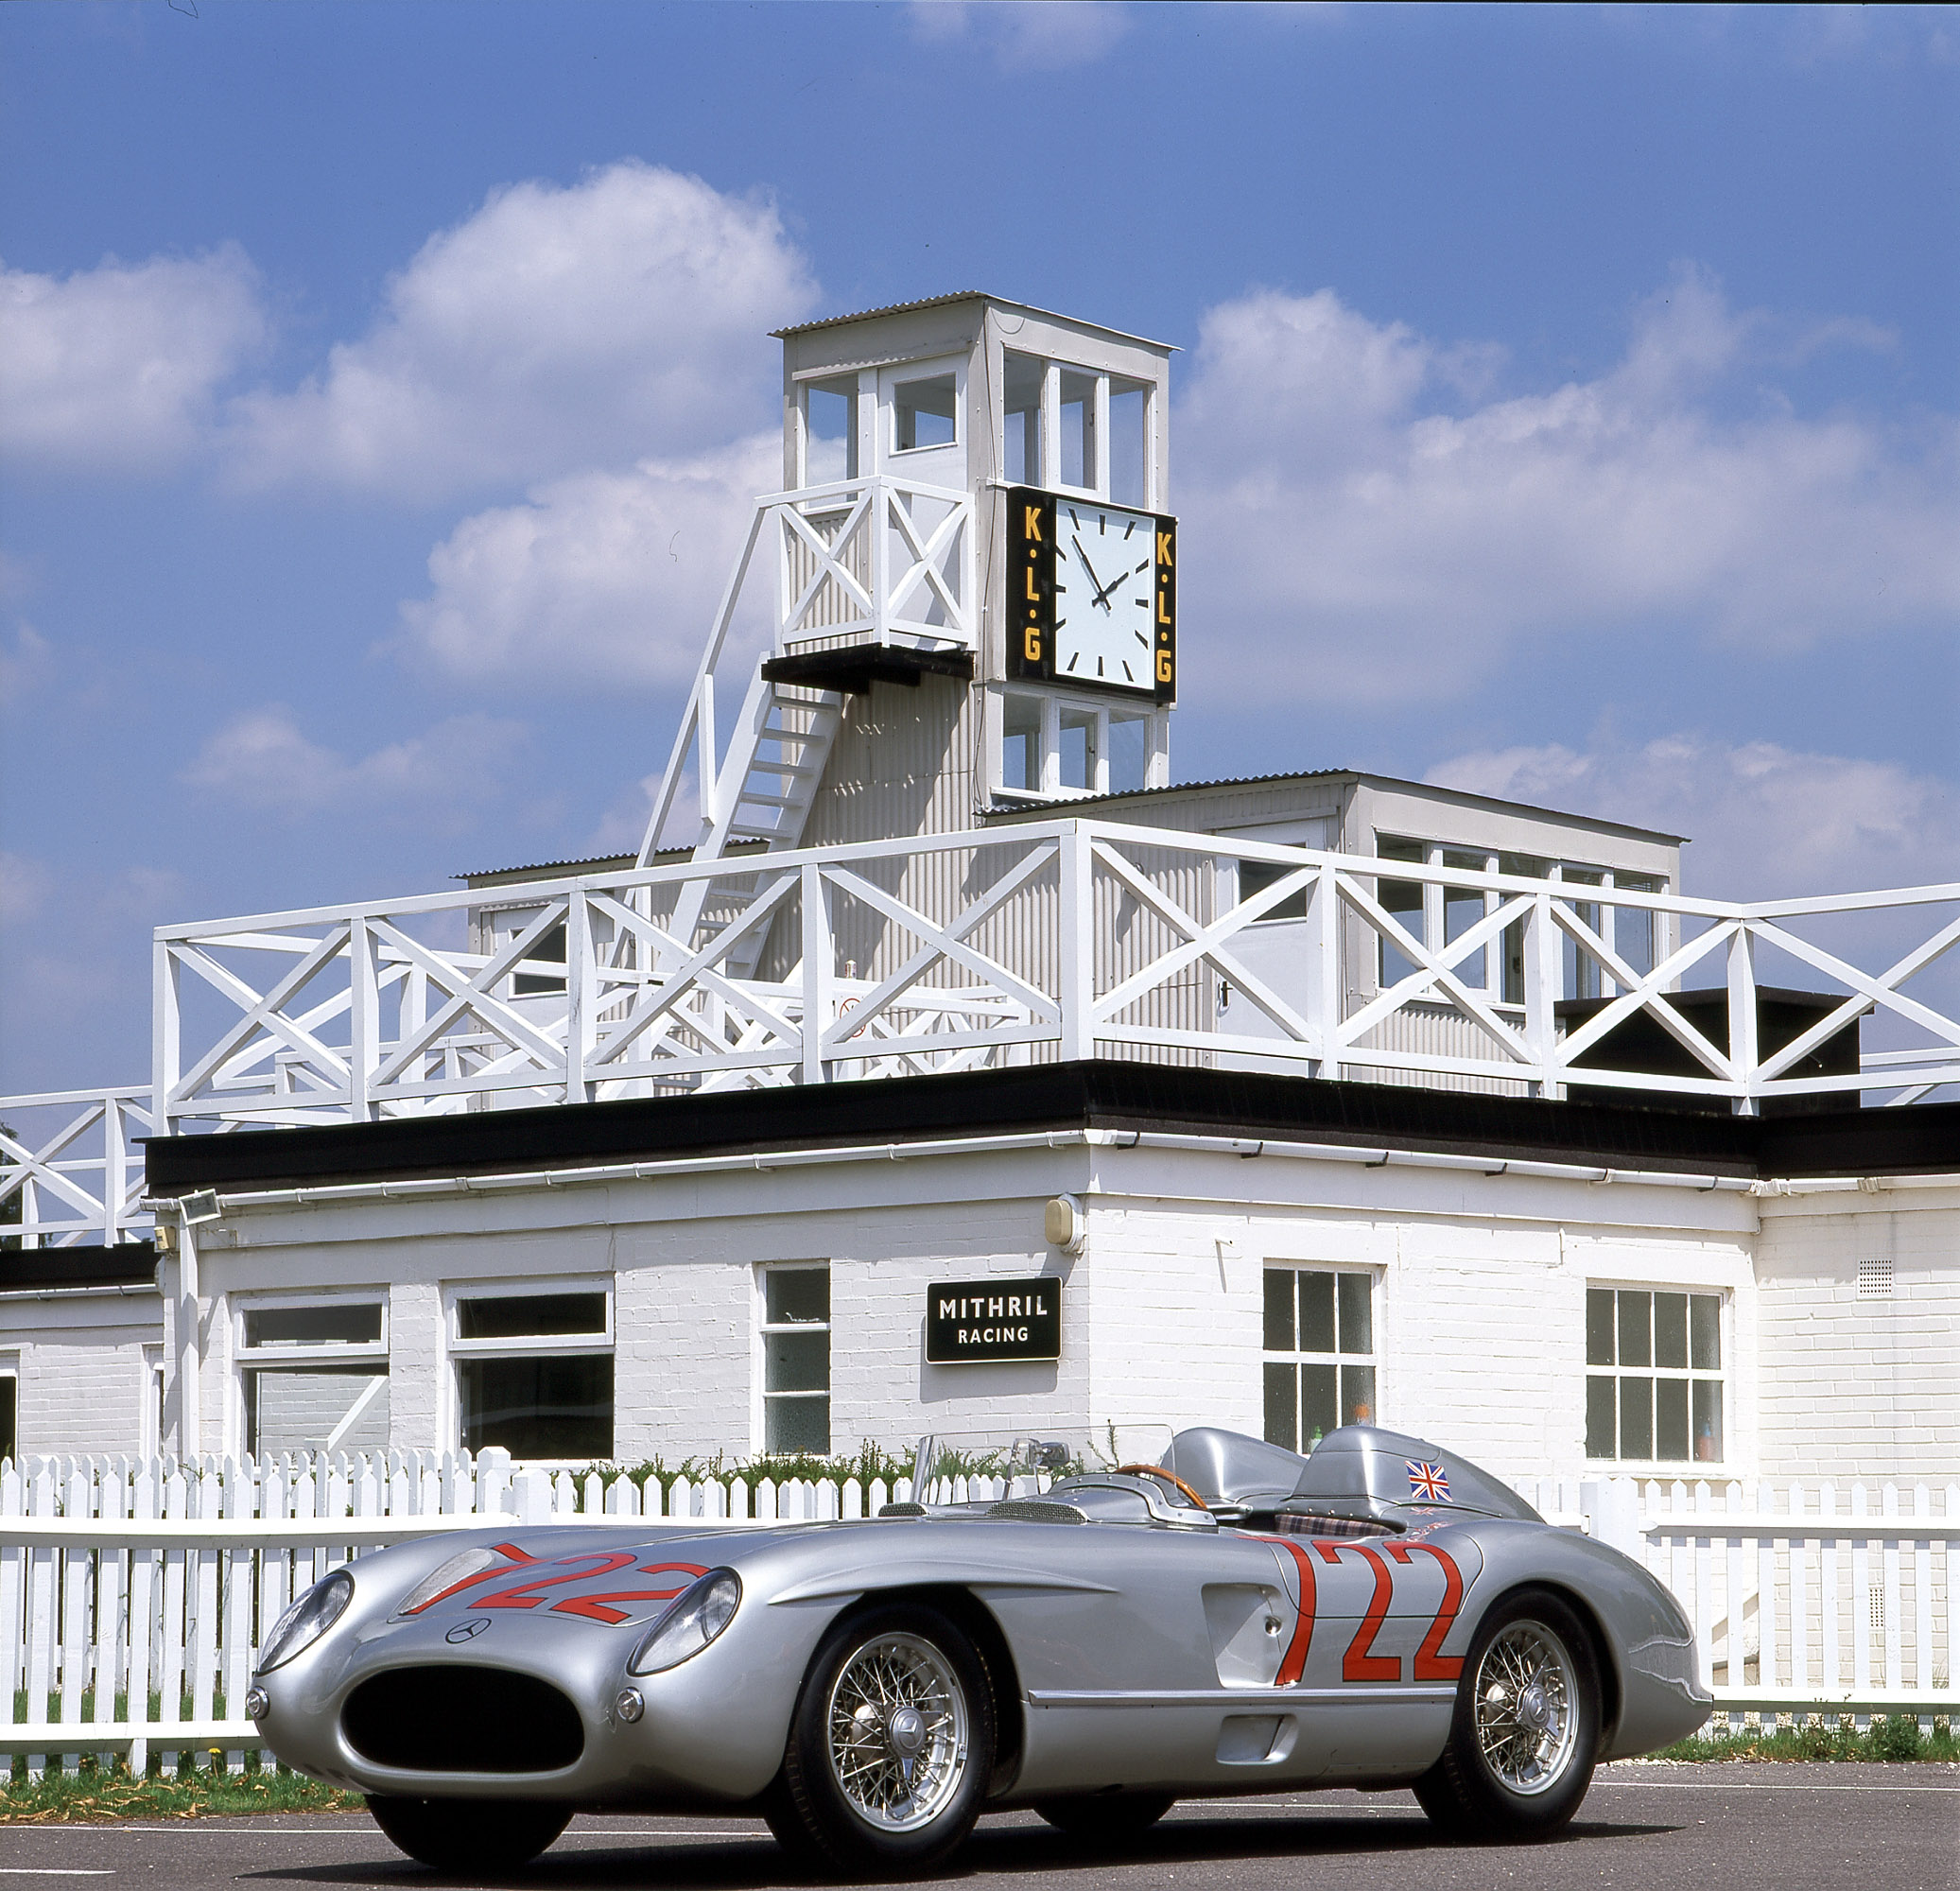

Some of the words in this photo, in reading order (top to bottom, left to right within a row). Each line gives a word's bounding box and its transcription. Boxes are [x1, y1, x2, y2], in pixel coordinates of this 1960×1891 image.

[940, 1295, 1048, 1319] MITHRIL
[958, 1327, 1029, 1344] RACING
[401, 1542, 711, 1625] 722
[1234, 1535, 1465, 1687] 722
